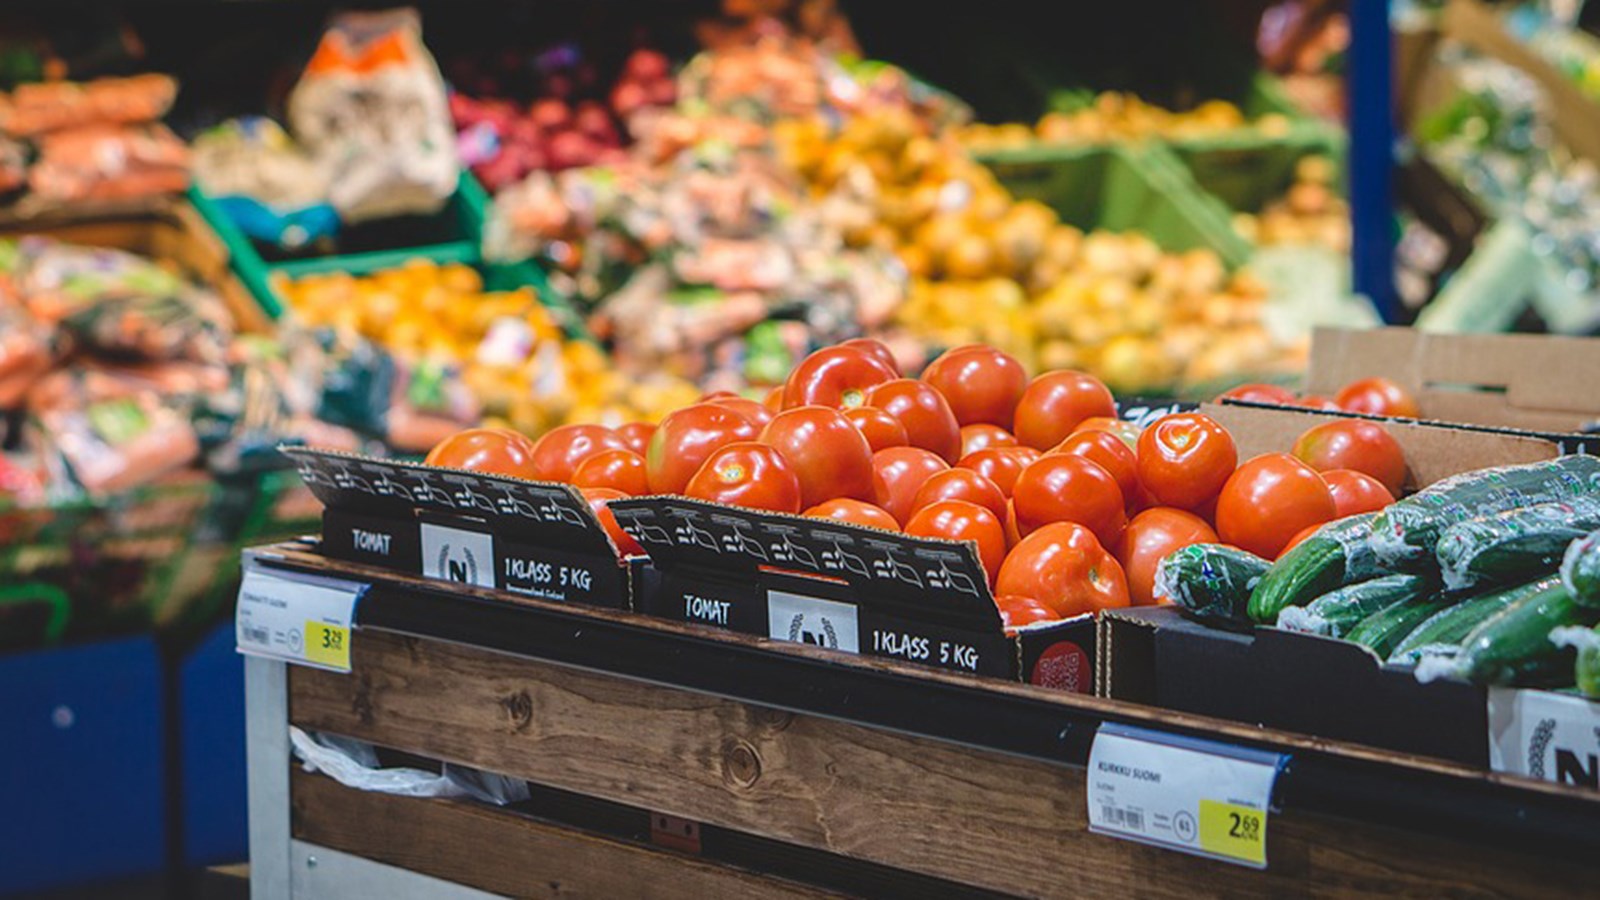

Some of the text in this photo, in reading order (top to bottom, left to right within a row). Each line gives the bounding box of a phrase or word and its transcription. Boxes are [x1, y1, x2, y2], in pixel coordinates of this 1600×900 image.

[352, 529, 392, 555] TOMAT
[449, 560, 466, 583] N
[560, 567, 568, 586] 5
[571, 568, 592, 591] KG
[684, 595, 731, 625] TOMAT
[940, 642, 950, 663] 5
[953, 644, 979, 671] KG
[1098, 761, 1162, 784] KURKKU SUOMI
[1555, 748, 1598, 790] N
